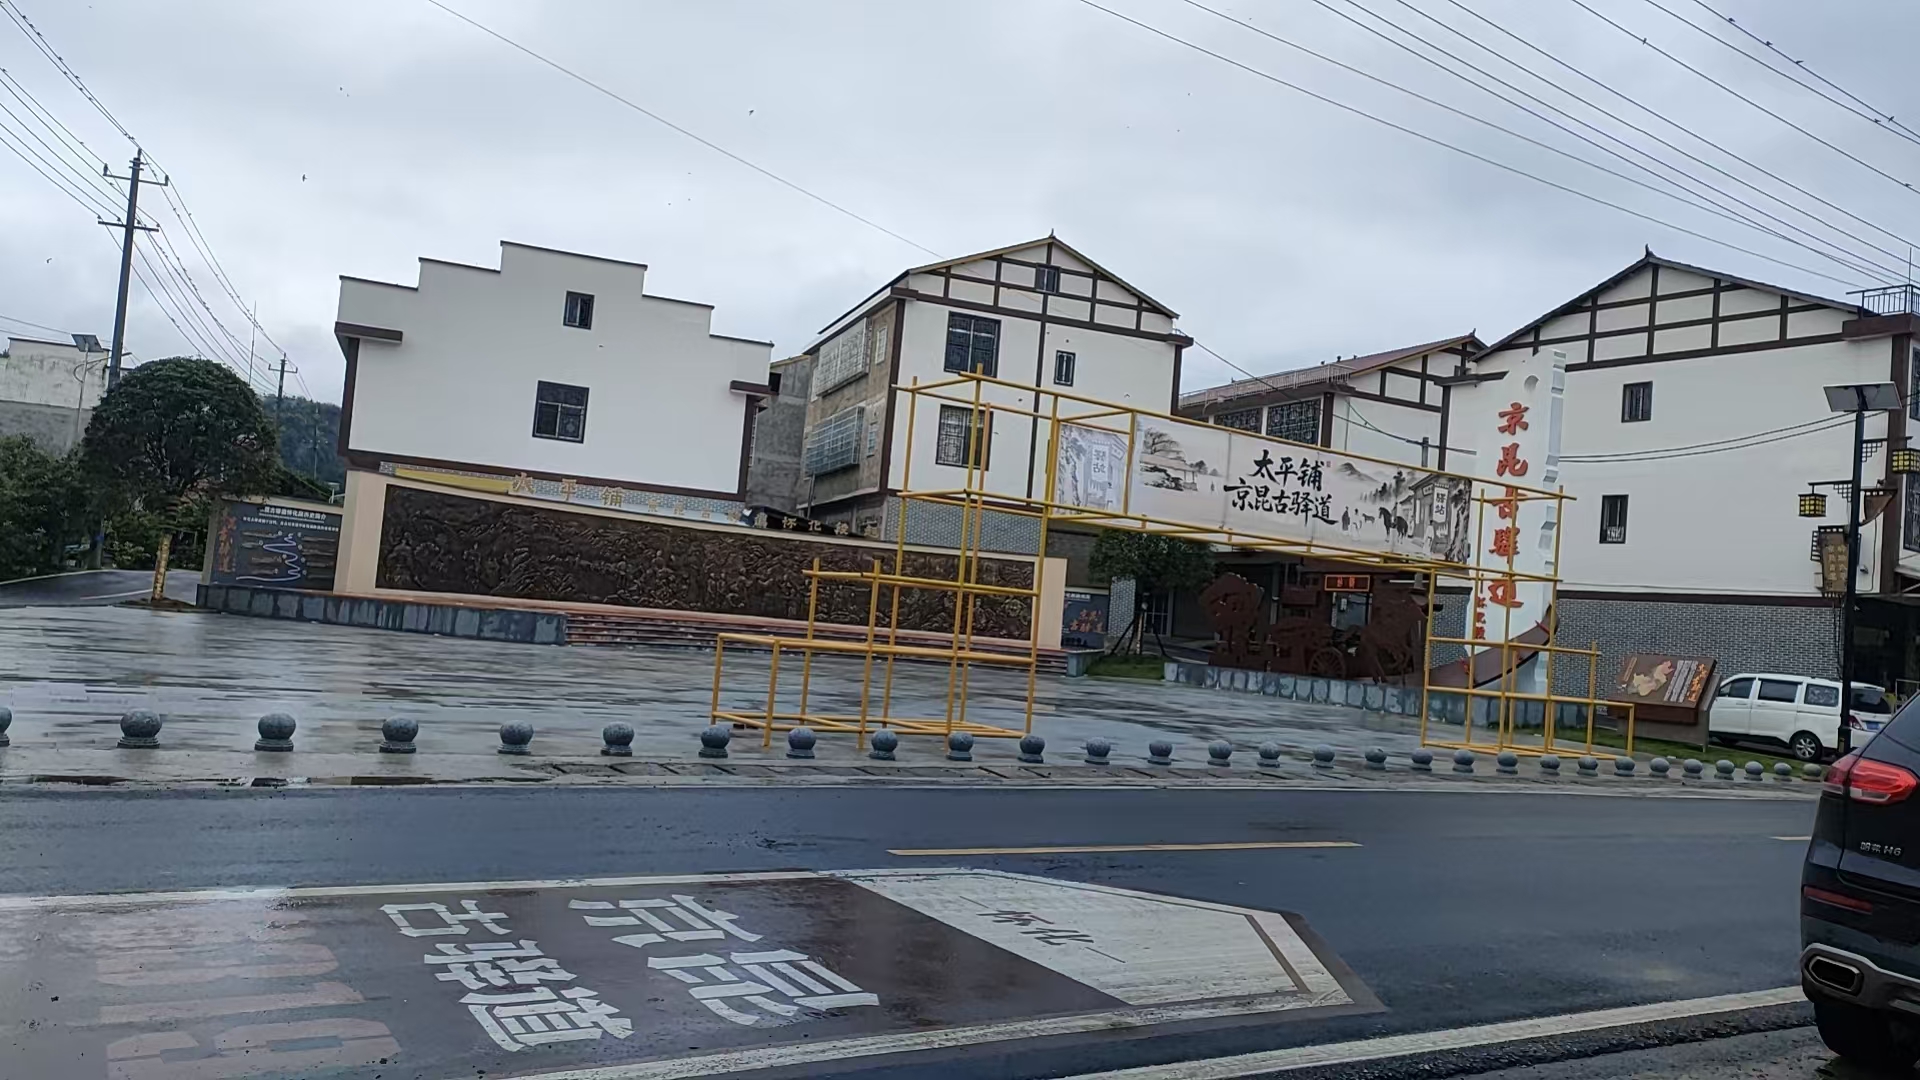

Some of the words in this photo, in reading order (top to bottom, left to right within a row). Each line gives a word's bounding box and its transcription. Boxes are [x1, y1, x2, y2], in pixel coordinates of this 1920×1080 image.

[1247, 449, 1325, 492] 太平铺
[1223, 477, 1339, 528] 京昆古驿道
[1883, 845, 1902, 856] H6
[568, 894, 880, 1026] 京昆
